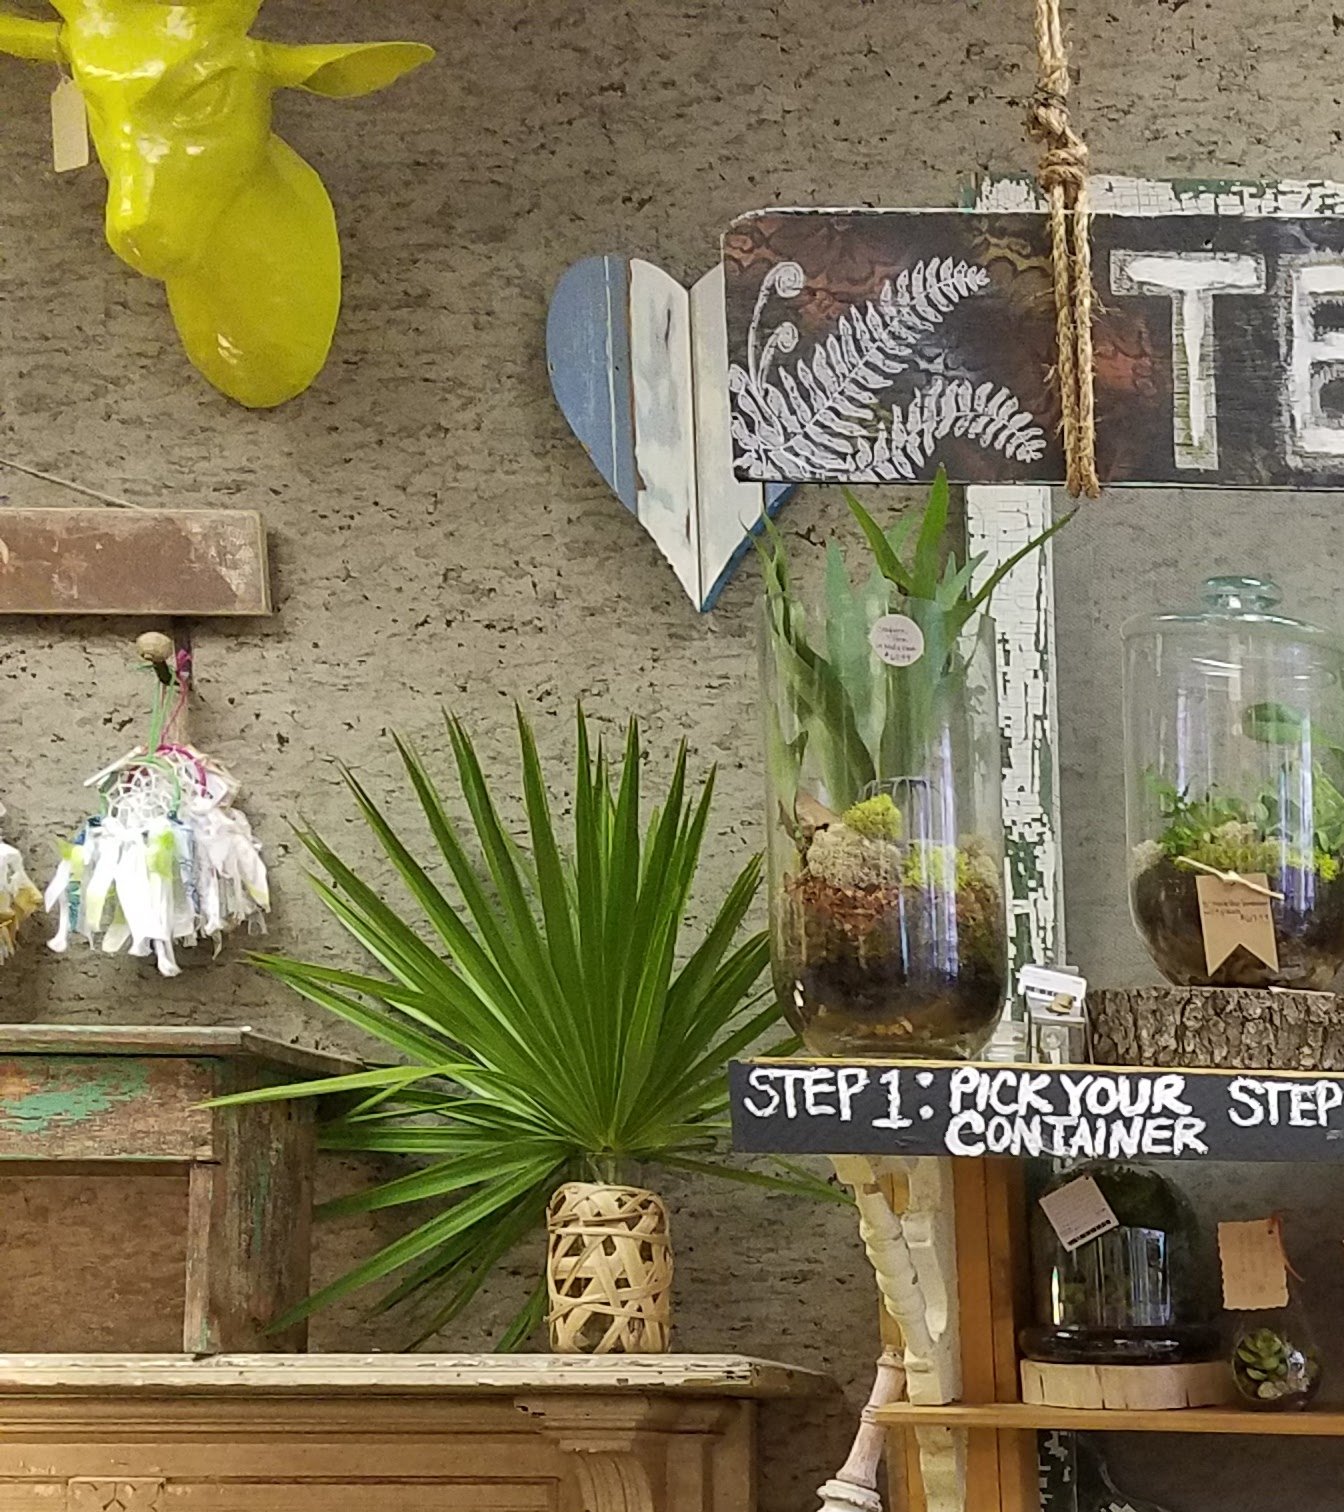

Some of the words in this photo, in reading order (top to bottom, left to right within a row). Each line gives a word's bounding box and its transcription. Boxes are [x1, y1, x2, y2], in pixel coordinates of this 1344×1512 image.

[743, 1067, 868, 1122] STEP
[871, 1070, 934, 1129] 1:
[950, 1066, 1053, 1117] PICK
[1059, 1073, 1194, 1117] YOUR
[1227, 1076, 1343, 1128] STEP
[944, 1110, 1210, 1158] CONTAINER
